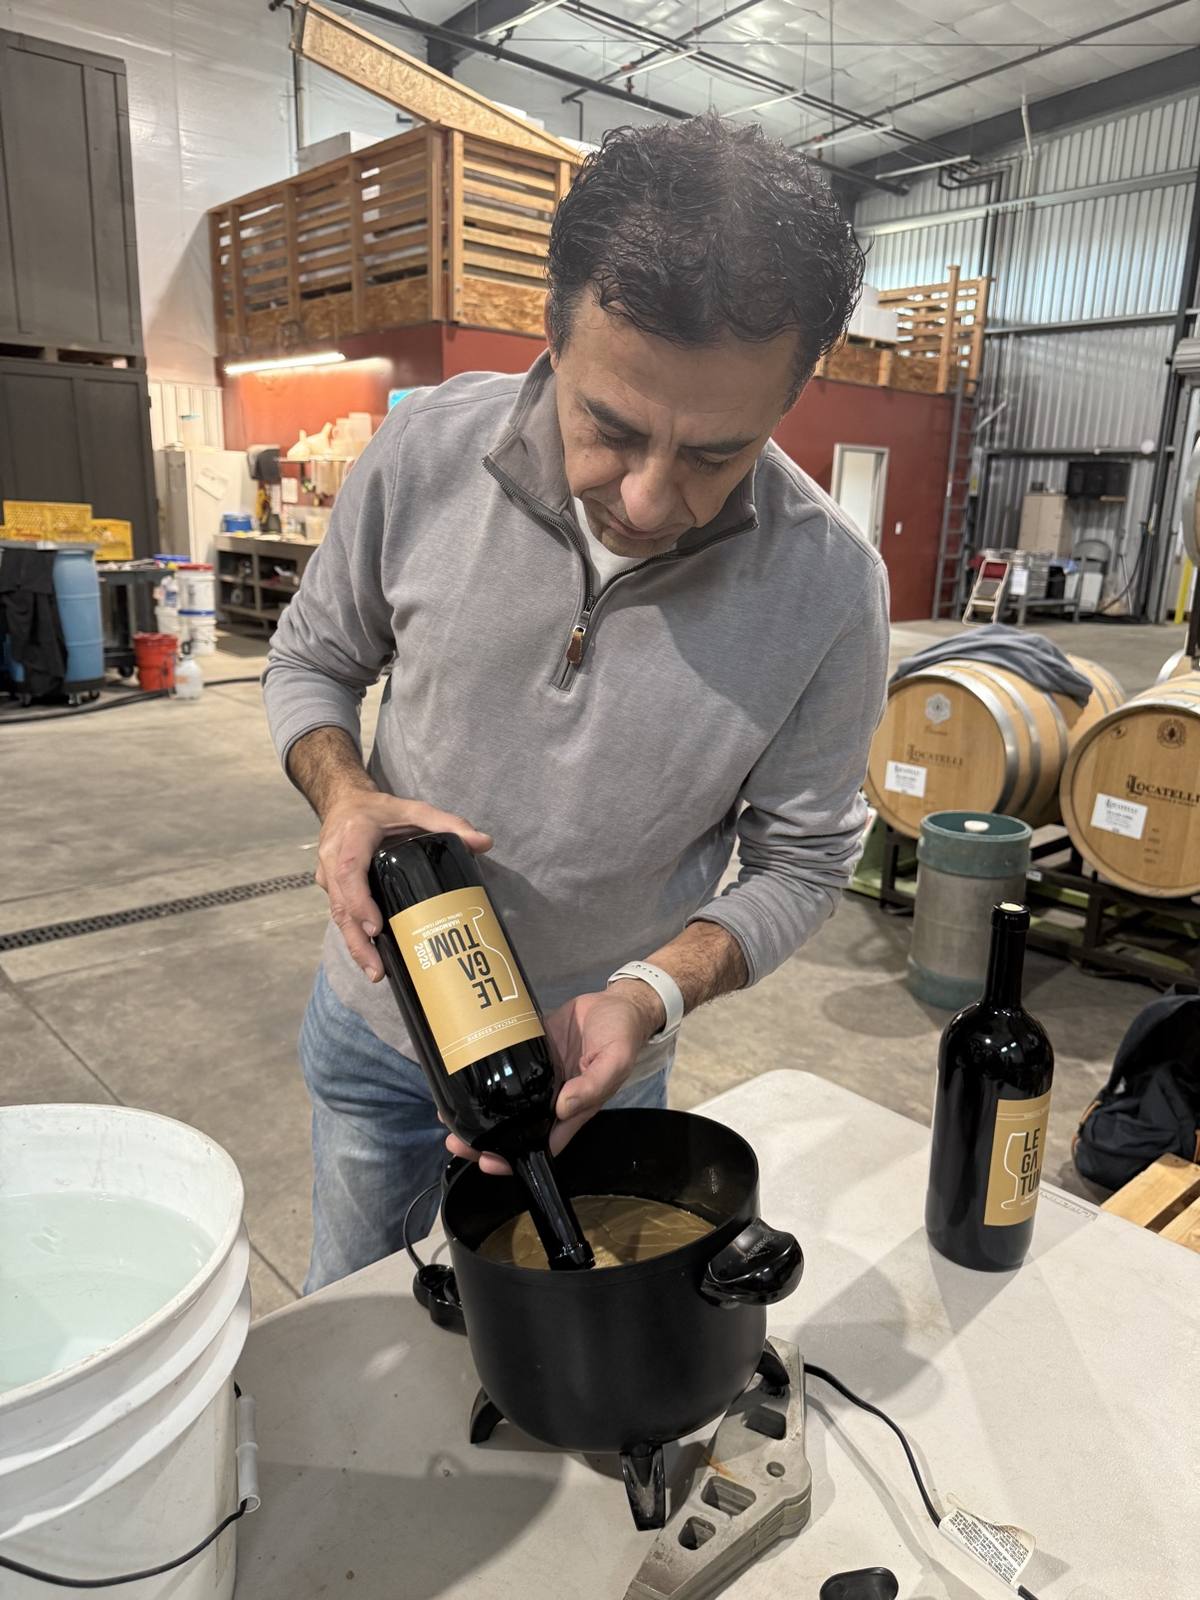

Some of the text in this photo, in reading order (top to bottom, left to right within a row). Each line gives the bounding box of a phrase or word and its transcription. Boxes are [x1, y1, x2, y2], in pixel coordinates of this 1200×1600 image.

[1127, 774, 1200, 803] LOCATELLI
[414, 942, 431, 970] 2020
[428, 924, 480, 963] TUM
[457, 950, 491, 981] GA
[472, 977, 503, 1009] LE
[1024, 1128, 1041, 1152] LE
[1021, 1151, 1038, 1174] GA
